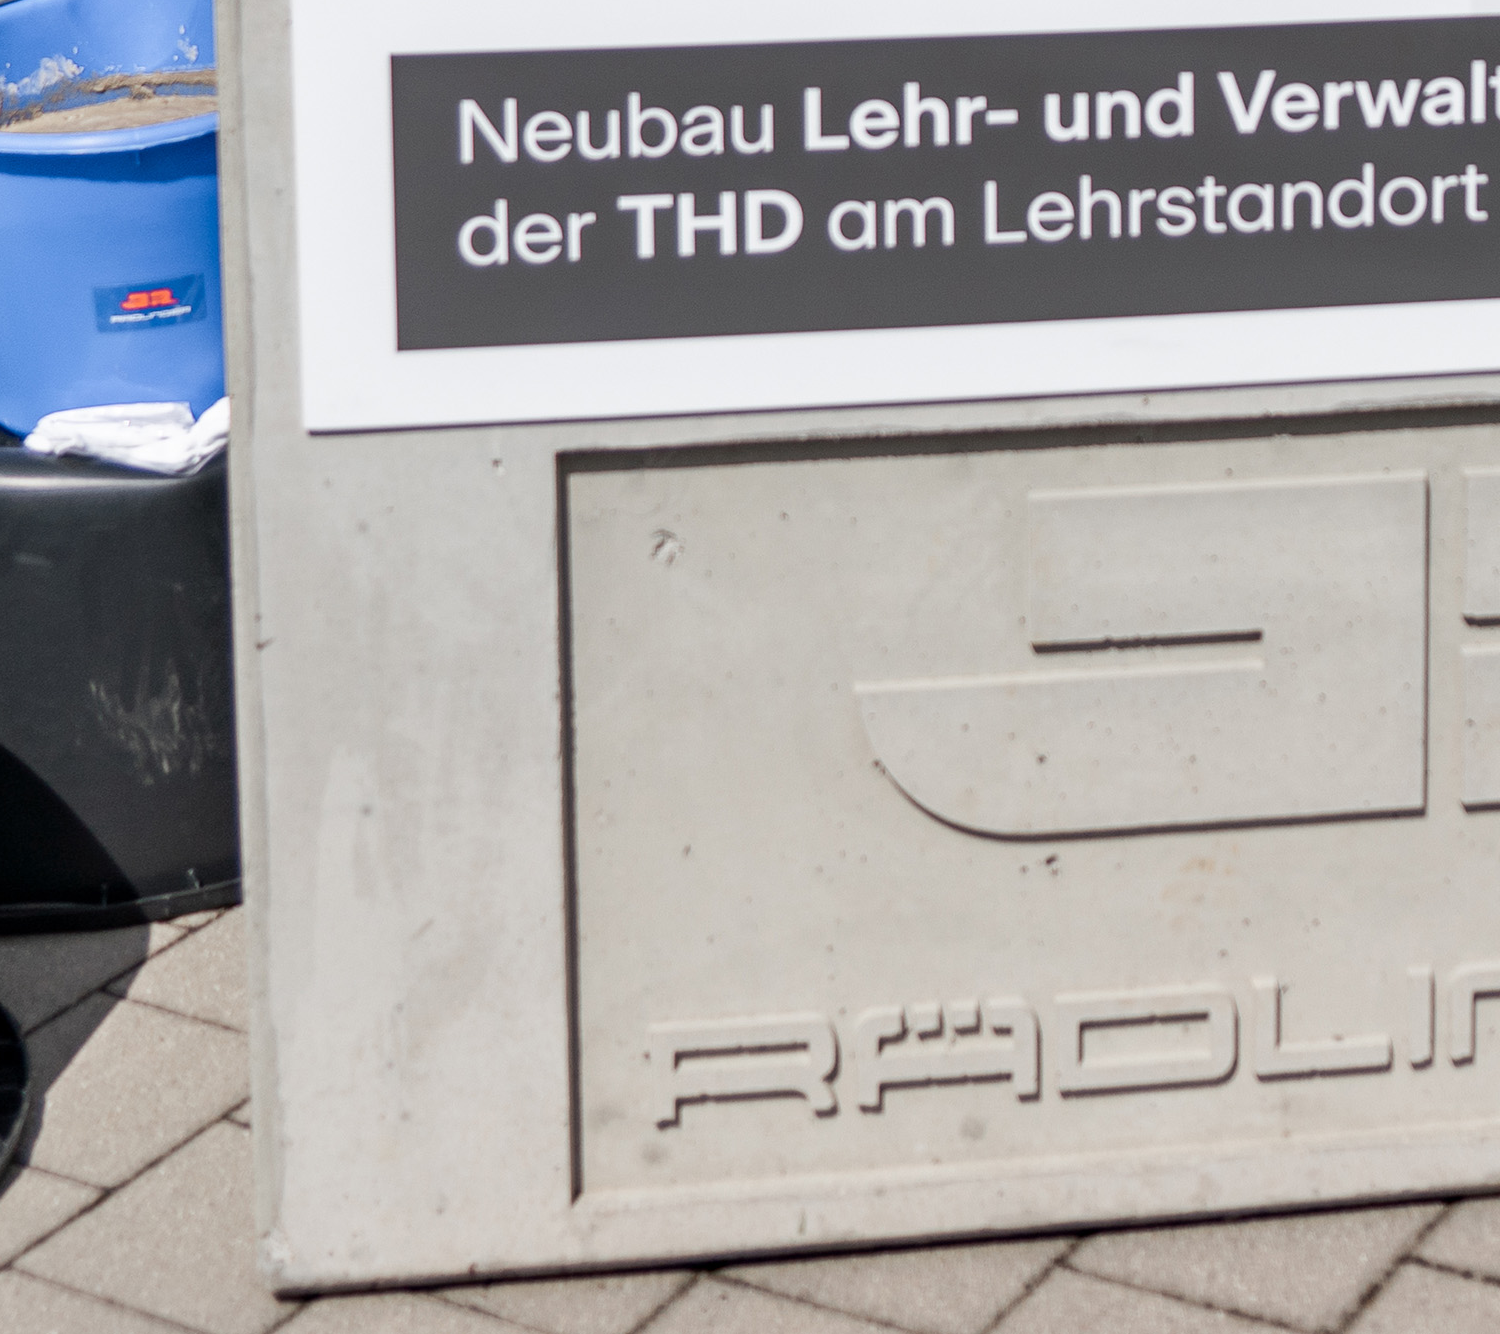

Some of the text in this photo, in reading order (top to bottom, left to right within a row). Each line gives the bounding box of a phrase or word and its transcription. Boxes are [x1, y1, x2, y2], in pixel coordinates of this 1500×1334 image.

[457, 94, 776, 165] Neubau
[803, 83, 1019, 154] Lehr-
[1046, 75, 1195, 141] und
[458, 197, 594, 266] der
[617, 190, 804, 259] THD
[828, 190, 956, 250] am
[983, 158, 1487, 245] Lehrstandort
